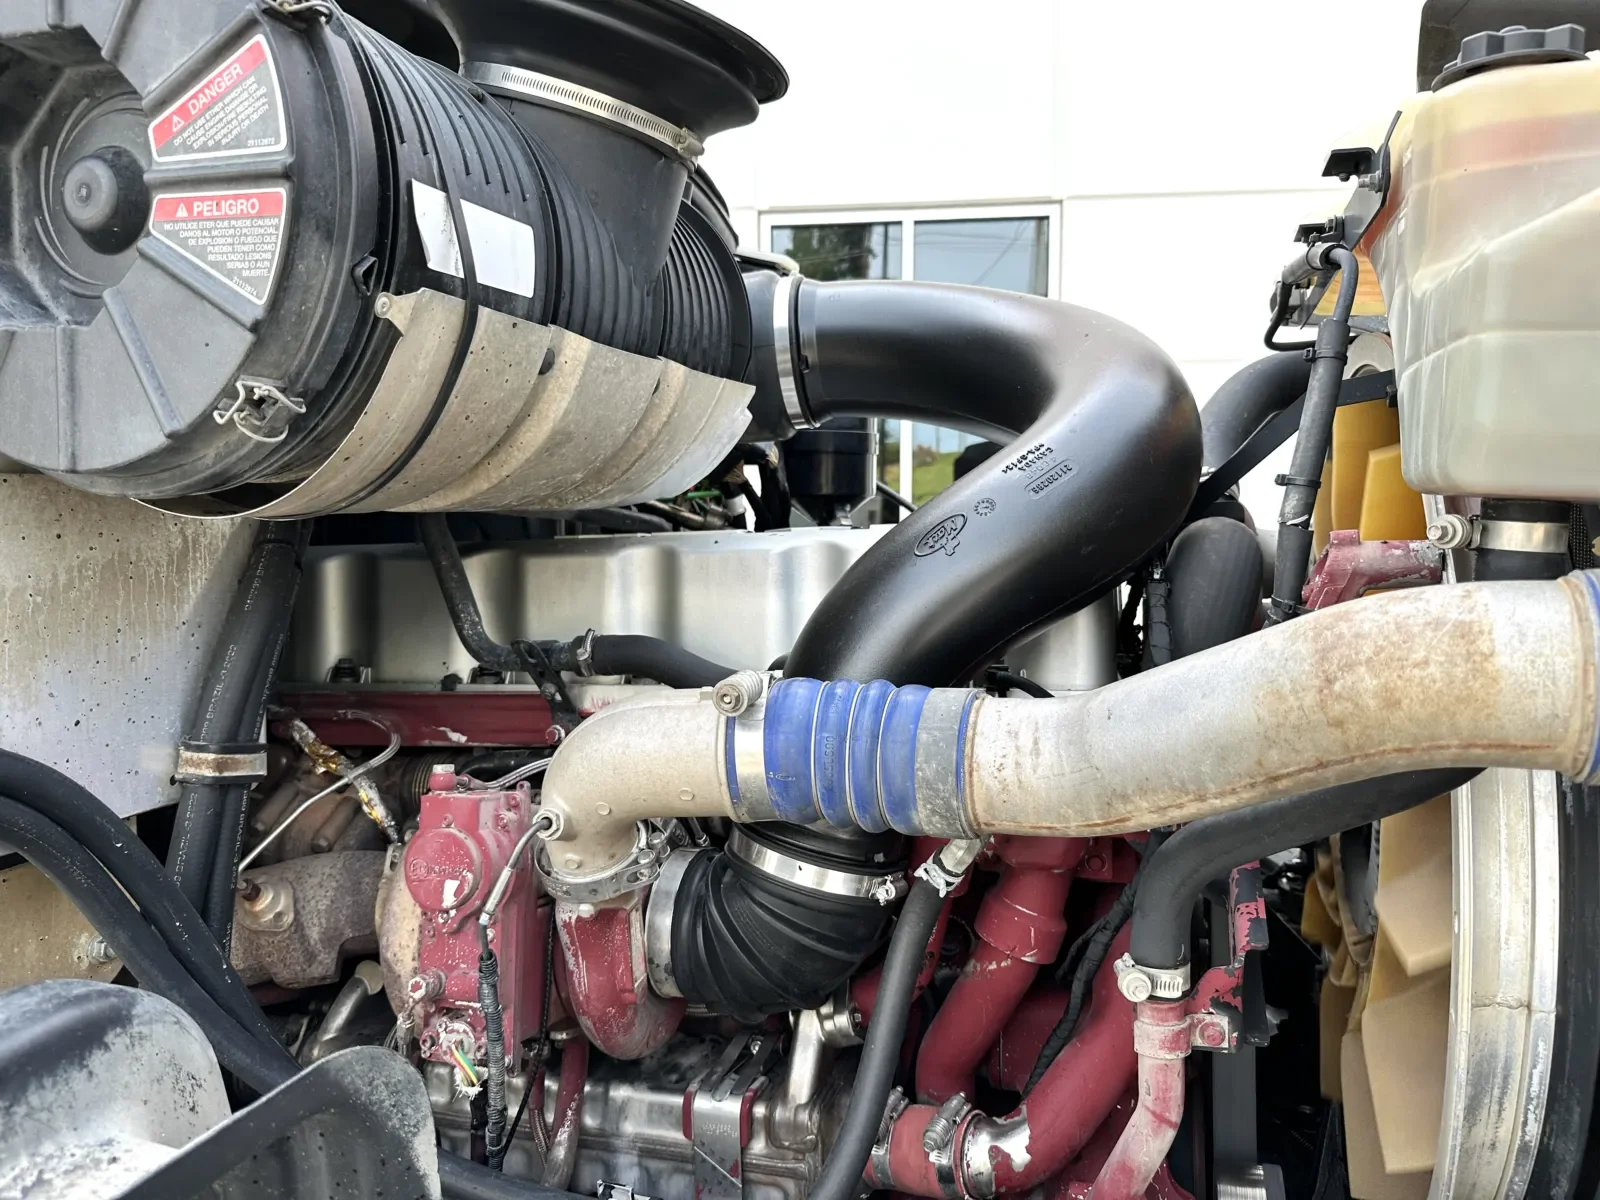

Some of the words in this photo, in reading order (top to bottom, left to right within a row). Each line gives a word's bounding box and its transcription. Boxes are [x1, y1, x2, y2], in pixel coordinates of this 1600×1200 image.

[188, 63, 243, 115] DANGER
[186, 126, 206, 145] CAUSE
[248, 82, 258, 94] OR
[241, 118, 250, 130] OR
[250, 104, 269, 122] DEATH
[173, 136, 183, 146] DO
[182, 126, 194, 140] NOT
[194, 116, 206, 130] USE
[193, 198, 259, 216] PELIGRO
[164, 222, 174, 231] NO
[174, 221, 198, 230] UTILICE
[198, 220, 214, 229] ETER
[216, 220, 230, 228] QUE
[230, 218, 252, 228] PUEDE
[252, 218, 279, 226] CAUSAR
[188, 238, 198, 246] DE
[198, 236, 234, 246] EXPLOSION
[234, 236, 240, 244] O
[240, 234, 263, 244] FUEGO
[263, 234, 278, 243] QUE
[202, 229, 211, 237] AL
[212, 228, 234, 236] MOTOR
[236, 228, 241, 236] O
[207, 244, 232, 254] PUEDEN
[234, 244, 254, 252] TENER
[255, 242, 276, 252] COMO
[208, 252, 244, 262] RESULTADO
[226, 260, 250, 269] SERIAS
[250, 260, 256, 268] O
[256, 260, 270, 268] AUN
[1018, 446, 1054, 472] CANADA
